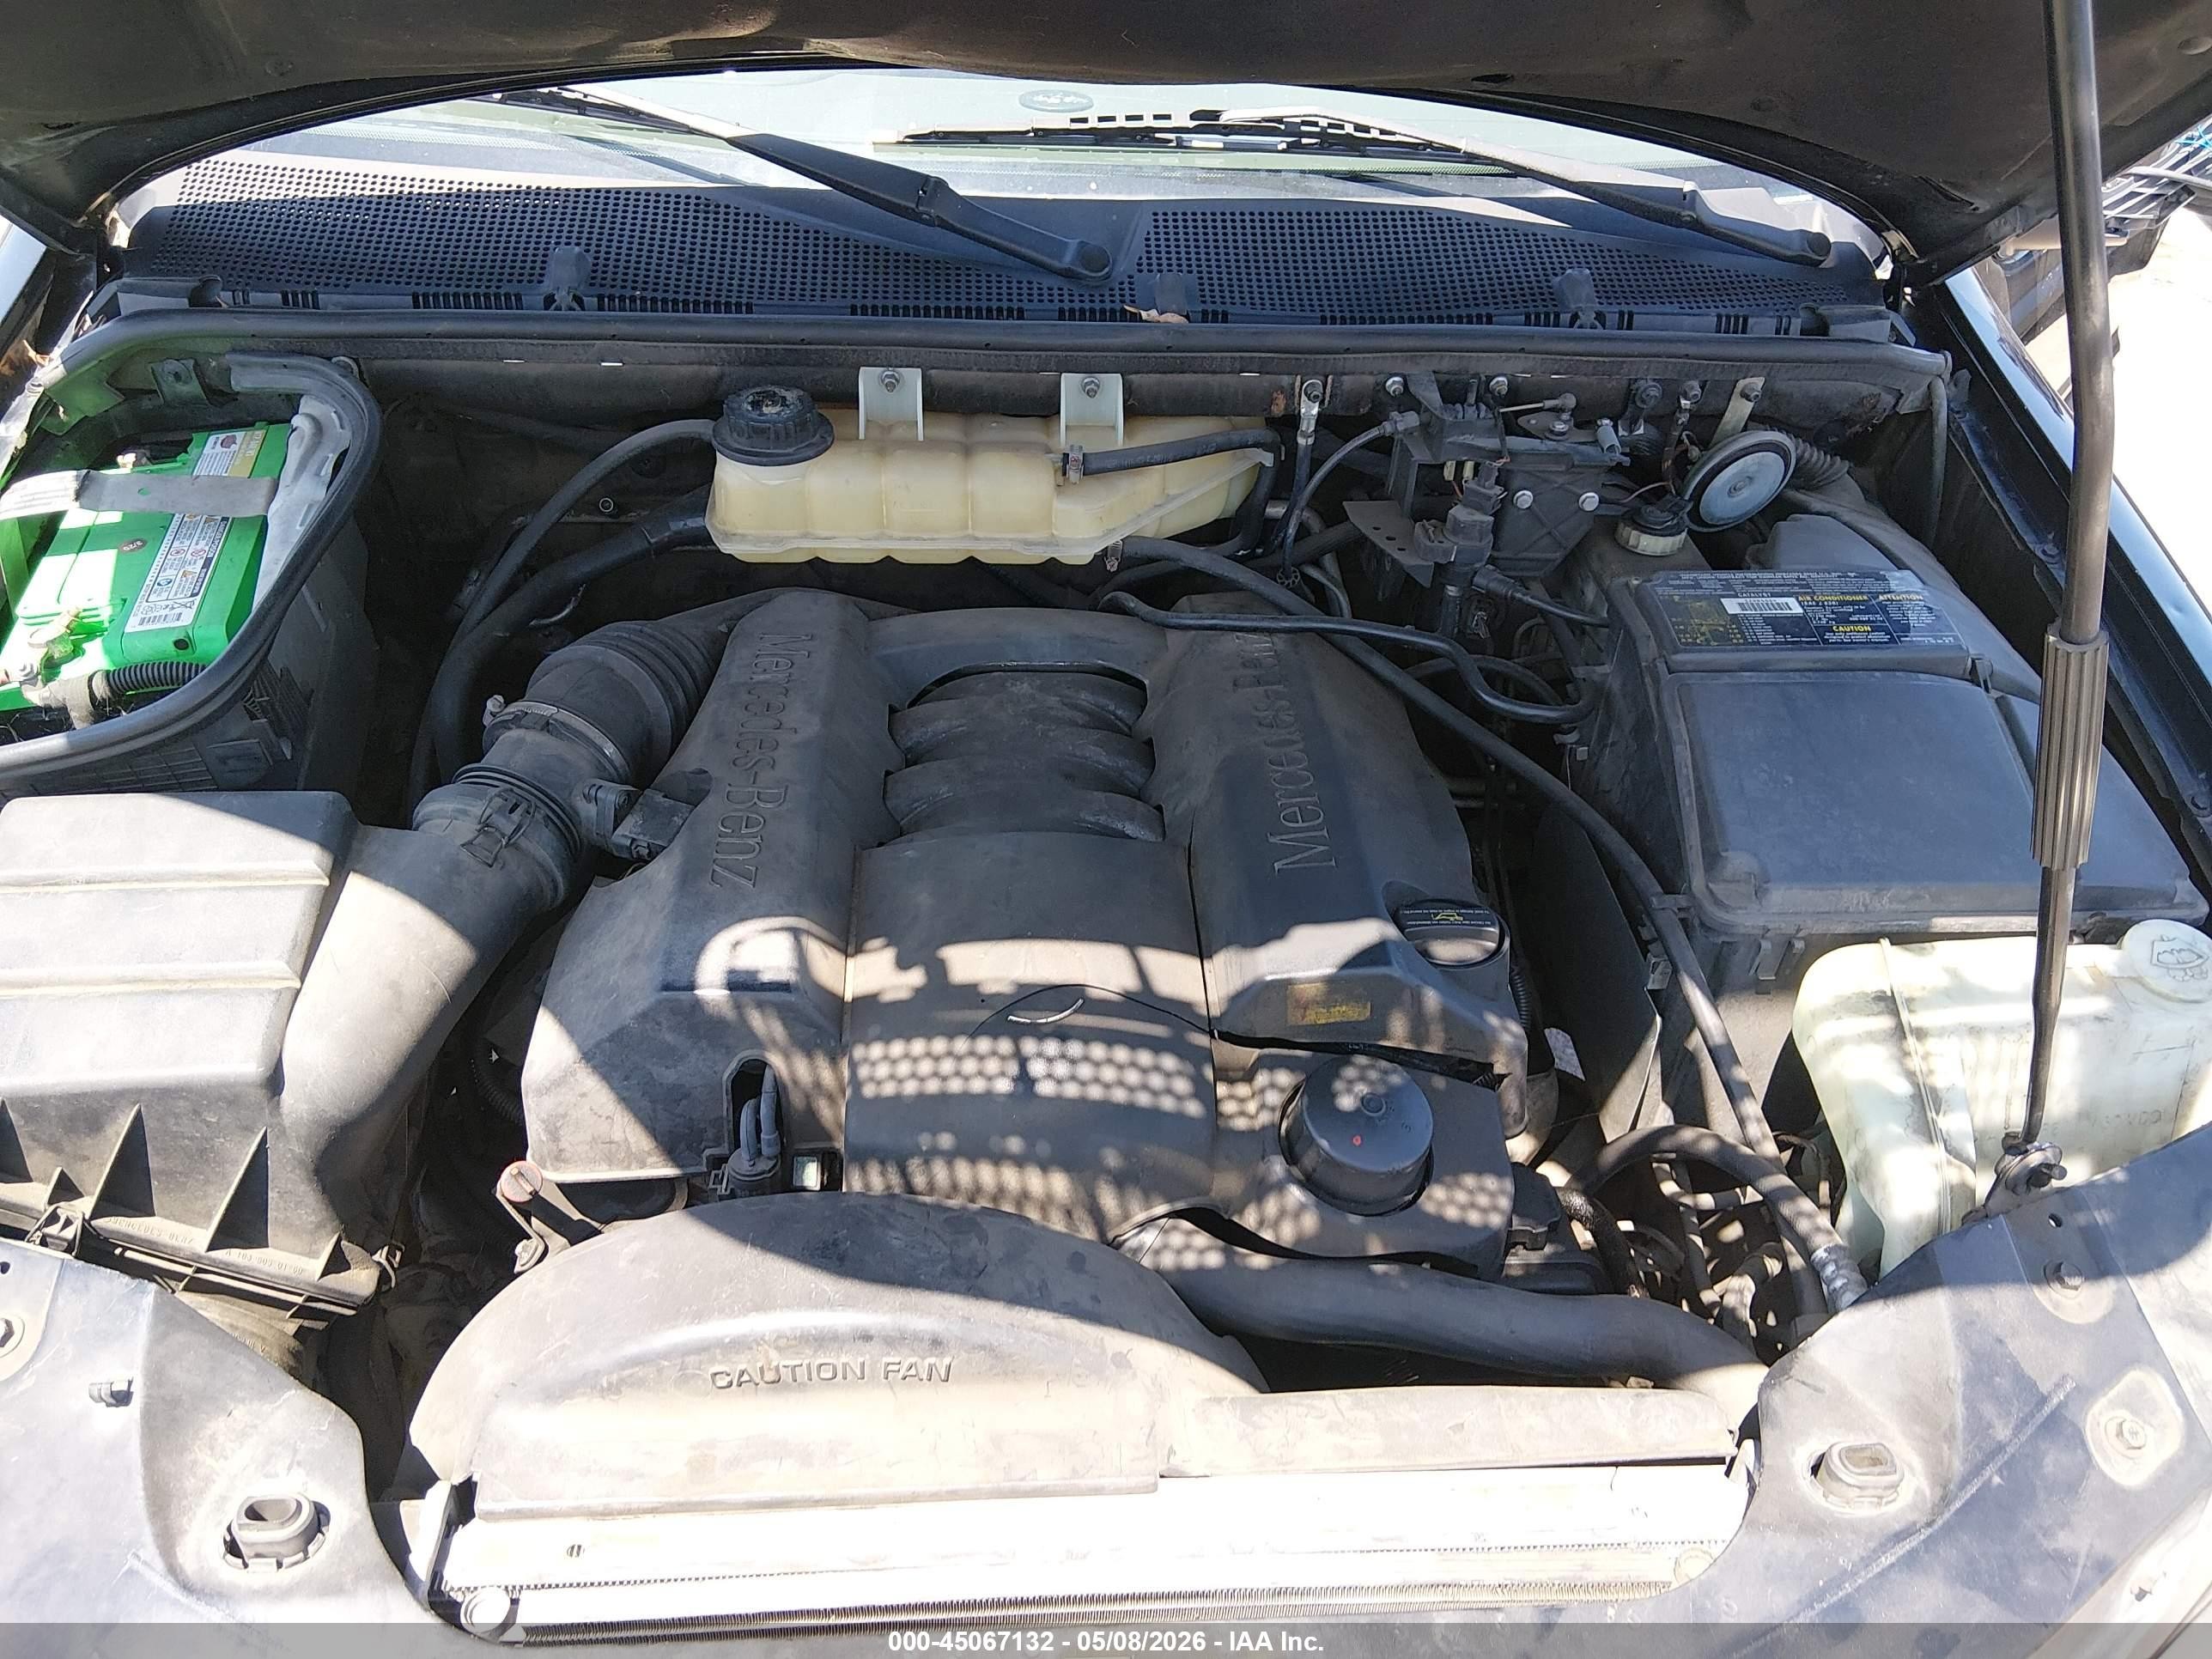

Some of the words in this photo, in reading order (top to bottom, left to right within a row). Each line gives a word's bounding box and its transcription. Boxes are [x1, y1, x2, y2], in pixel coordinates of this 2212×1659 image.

[708, 633, 813, 889] Mercedes-Benz
[709, 1359, 866, 1389] CAUTION
[882, 1356, 954, 1382] FAN
